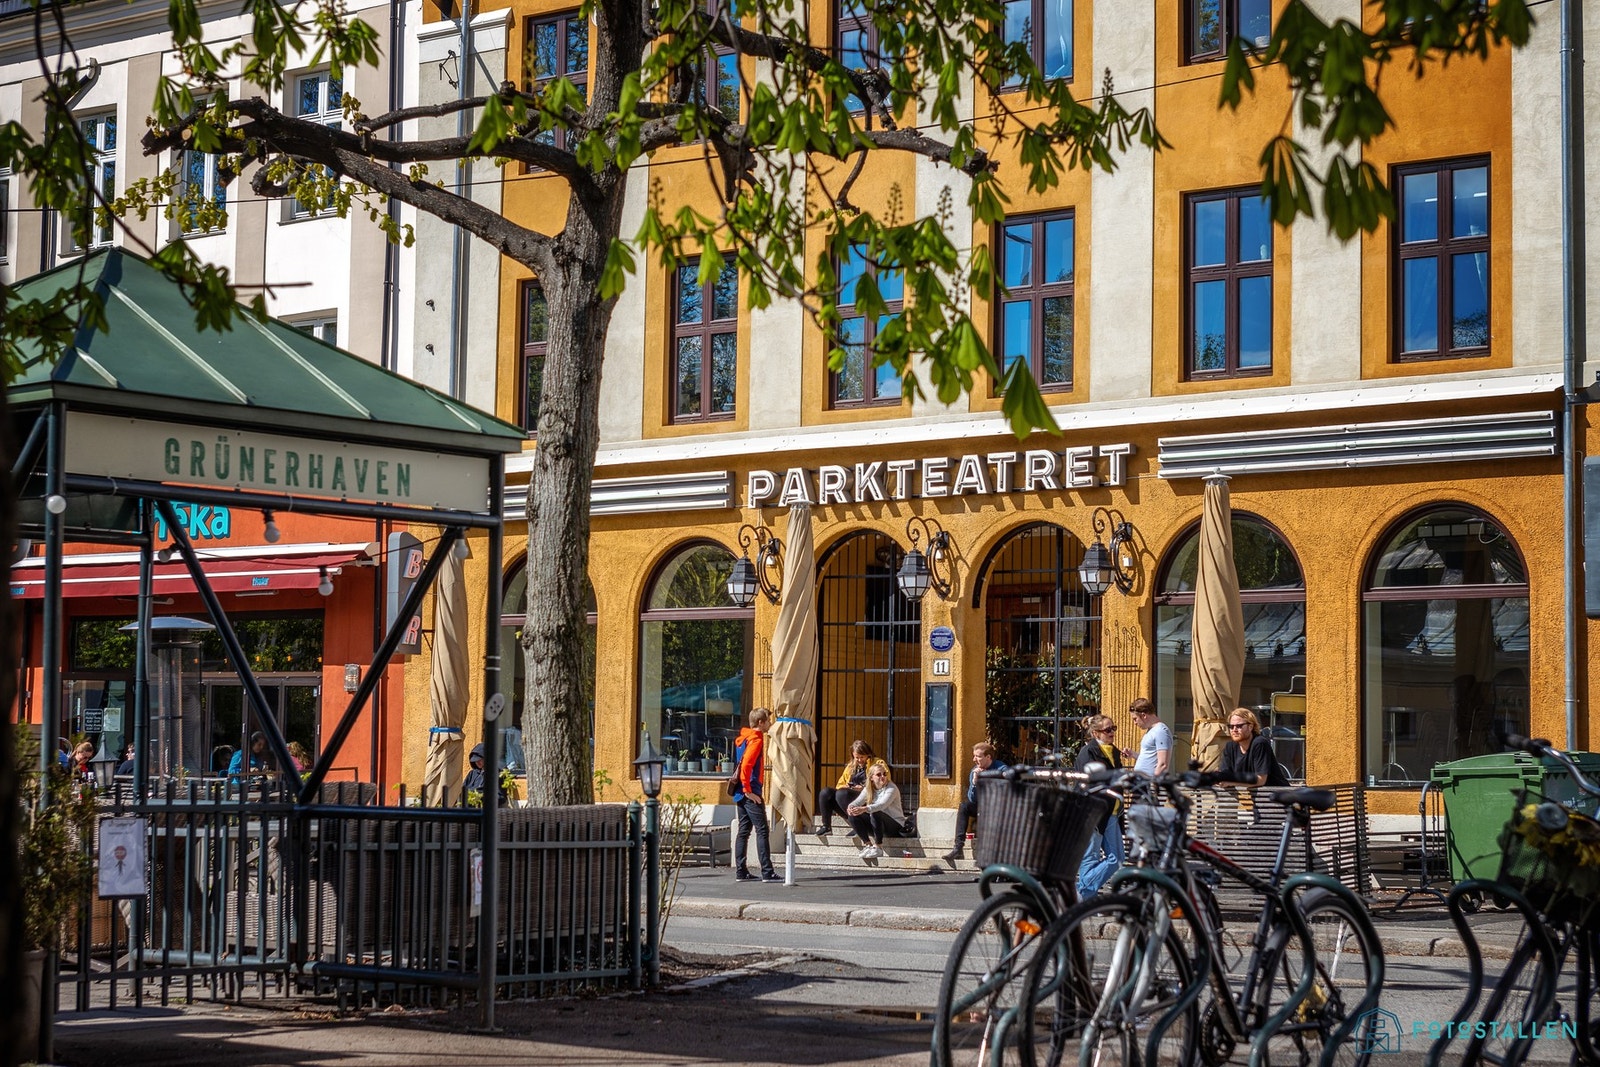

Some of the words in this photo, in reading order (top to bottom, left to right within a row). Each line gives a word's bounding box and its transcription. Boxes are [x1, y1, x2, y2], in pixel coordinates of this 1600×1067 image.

[165, 435, 411, 497] GRÜNERHAVEN
[747, 442, 1135, 509] PARKTEATRET
[402, 548, 422, 645] BR
[935, 661, 946, 673] 11
